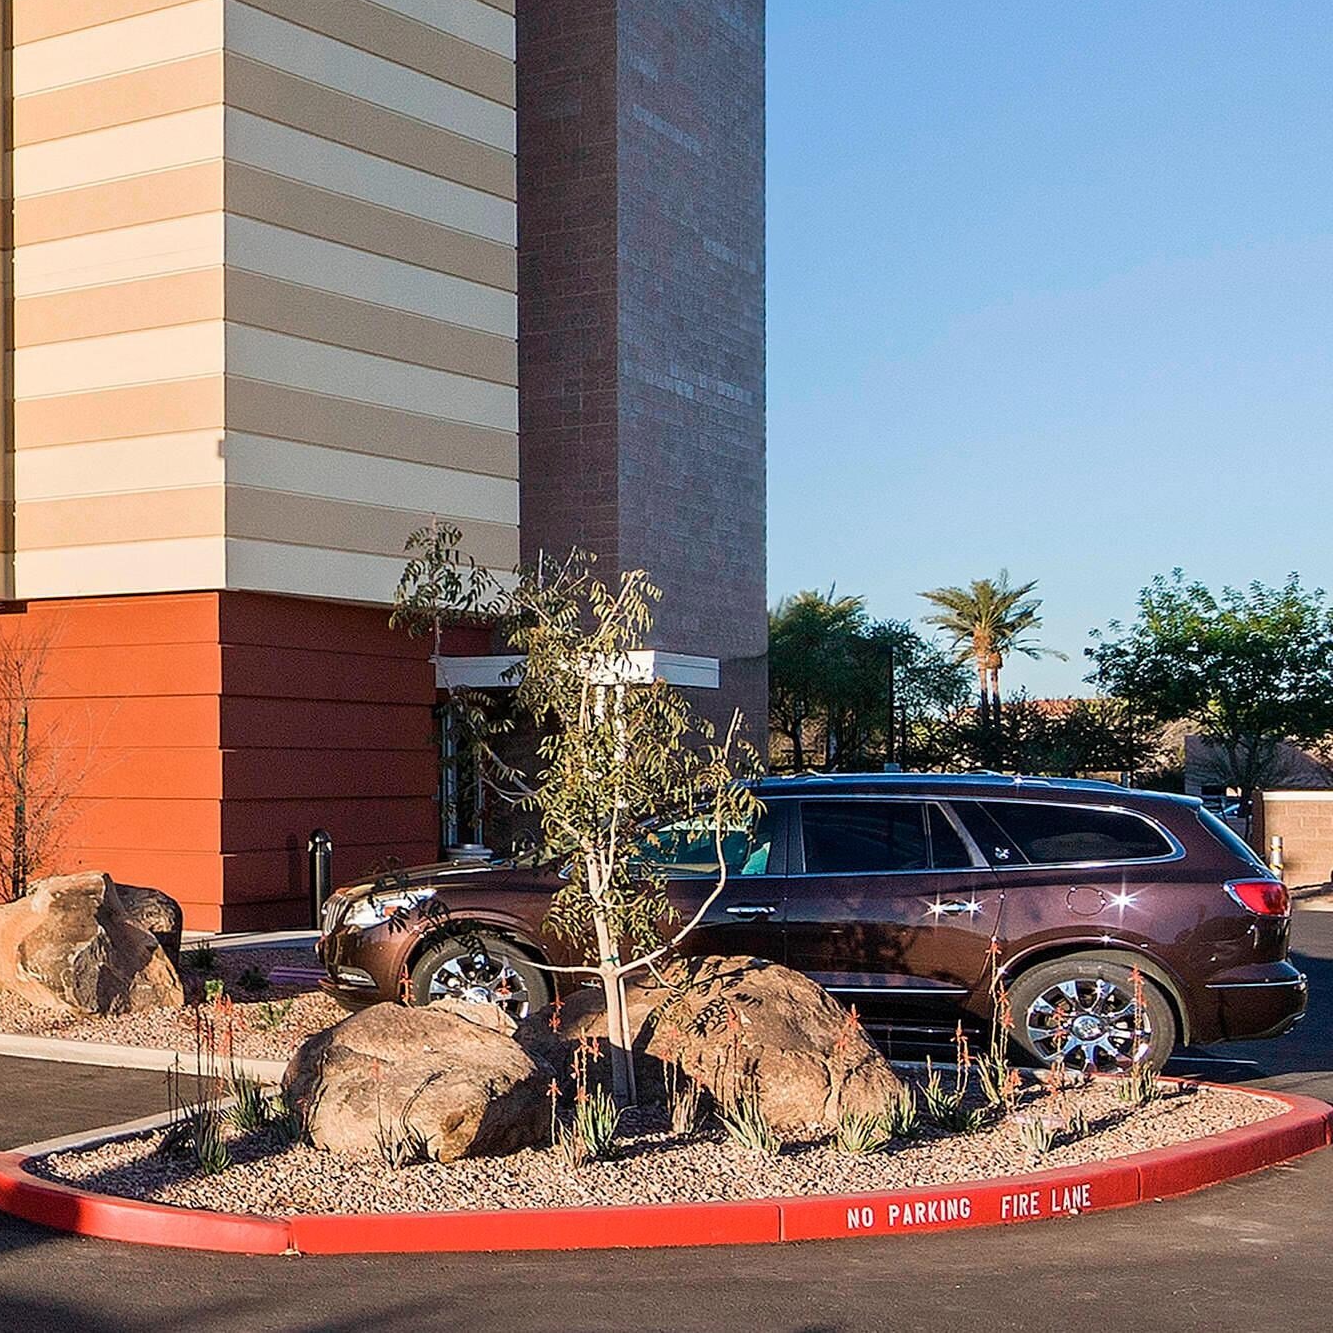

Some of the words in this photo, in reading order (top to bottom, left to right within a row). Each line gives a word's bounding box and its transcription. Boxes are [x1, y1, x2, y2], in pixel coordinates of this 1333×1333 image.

[846, 1207, 874, 1229] NO
[888, 1197, 971, 1226] PARKING
[1001, 1191, 1040, 1219] FIRE
[1051, 1184, 1091, 1212] LANE
